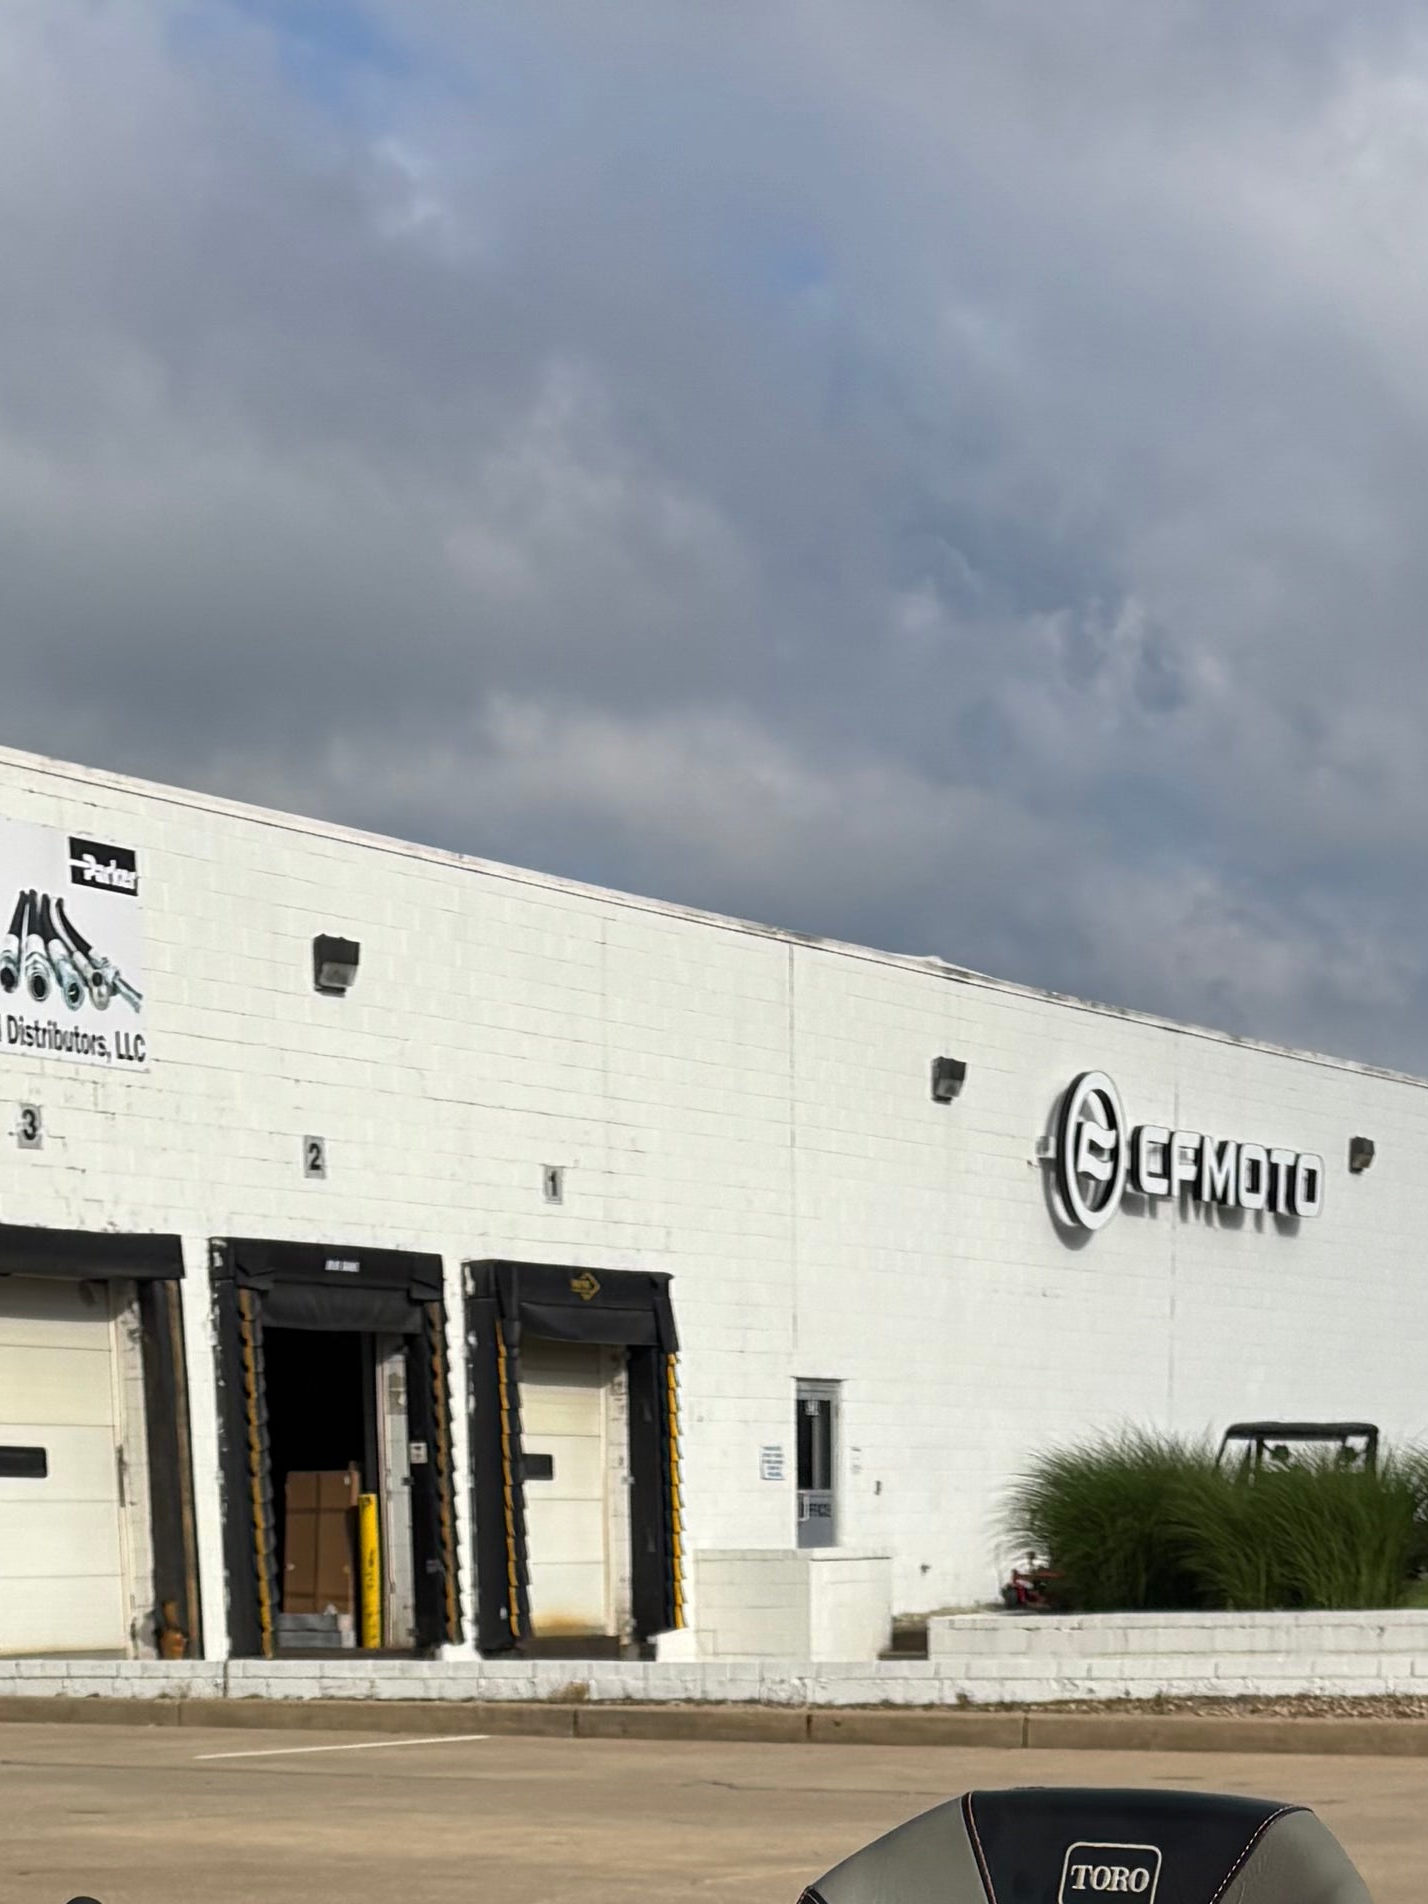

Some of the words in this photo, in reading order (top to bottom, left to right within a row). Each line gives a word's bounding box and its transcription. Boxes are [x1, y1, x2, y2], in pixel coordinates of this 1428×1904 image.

[81, 853, 137, 890] Parker
[7, 1014, 112, 1063] Distributors,
[115, 1030, 146, 1063] LLC
[21, 1109, 37, 1141] 3
[308, 1142, 322, 1171] 2
[1131, 1124, 1325, 1217] CFMOTO
[548, 1170, 558, 1197] 1
[1070, 1864, 1150, 1893] TORO
